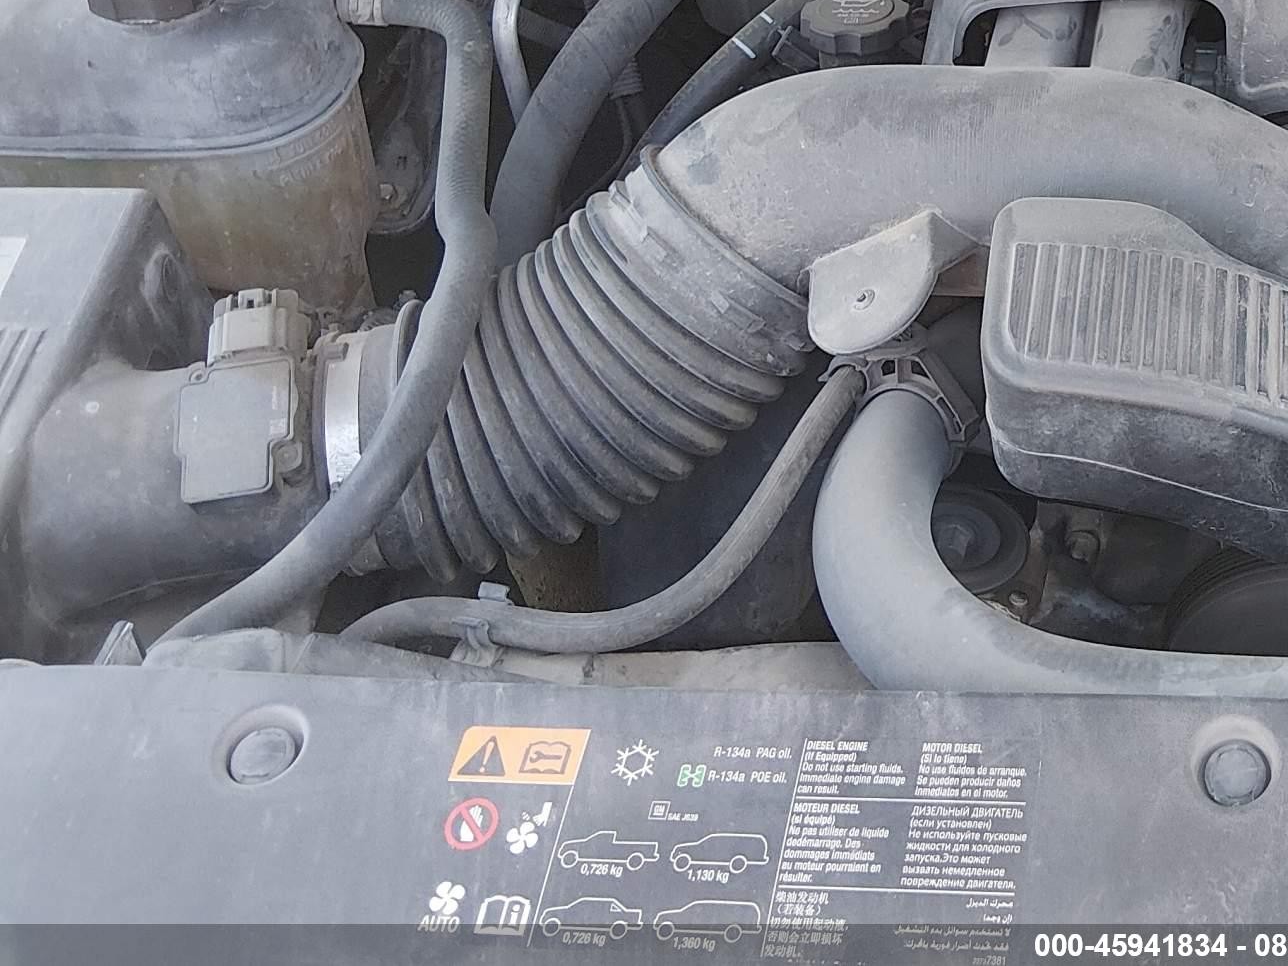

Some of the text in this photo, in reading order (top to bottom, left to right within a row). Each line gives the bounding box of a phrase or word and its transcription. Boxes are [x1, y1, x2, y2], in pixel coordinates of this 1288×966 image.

[806, 740, 868, 752] DIESEL ENGINE
[922, 742, 982, 754] MOTOR DIESEL
[714, 746, 792, 759] R-134a PAG oil.
[815, 752, 856, 763] Equipped)
[944, 754, 968, 765] tiene)
[802, 762, 904, 774] Do not use starting fluids.
[918, 764, 1027, 777] No use fluidos de arranque.
[708, 771, 788, 784] R-134a POE oil.
[800, 772, 906, 786] Immediate engine damage
[916, 775, 1022, 788] Se pueden producir daños
[798, 784, 840, 794] can result.
[961, 788, 972, 797] en
[974, 788, 982, 798] el
[982, 789, 1008, 798] motor.
[793, 802, 860, 814] MOTEUR DIESEL
[911, 804, 1024, 818] ДИЗЕЛЬНЫЙ ДВИГАТЕЛЬ
[804, 814, 836, 826] équipé)
[910, 817, 992, 830] (если установлен)
[788, 826, 890, 838] Ne pas utiliser de liquide
[908, 828, 1028, 842] Не используйте пусковые
[845, 838, 862, 848] Des
[906, 842, 1021, 854] жидкости для холодного
[784, 848, 876, 861] dommages immédiats
[960, 855, 992, 864] может
[580, 864, 623, 878] 0,726 kg
[781, 861, 882, 873] au moteur pourraient en
[902, 865, 1006, 876] вызвать немедленное
[687, 870, 730, 884] 1,130 kg
[779, 872, 812, 882] résulter.
[900, 876, 1016, 890] повреждение двигателя.
[418, 914, 460, 933] AUTO
[562, 932, 606, 947] 0,726 kg
[702, 938, 716, 952] kg
